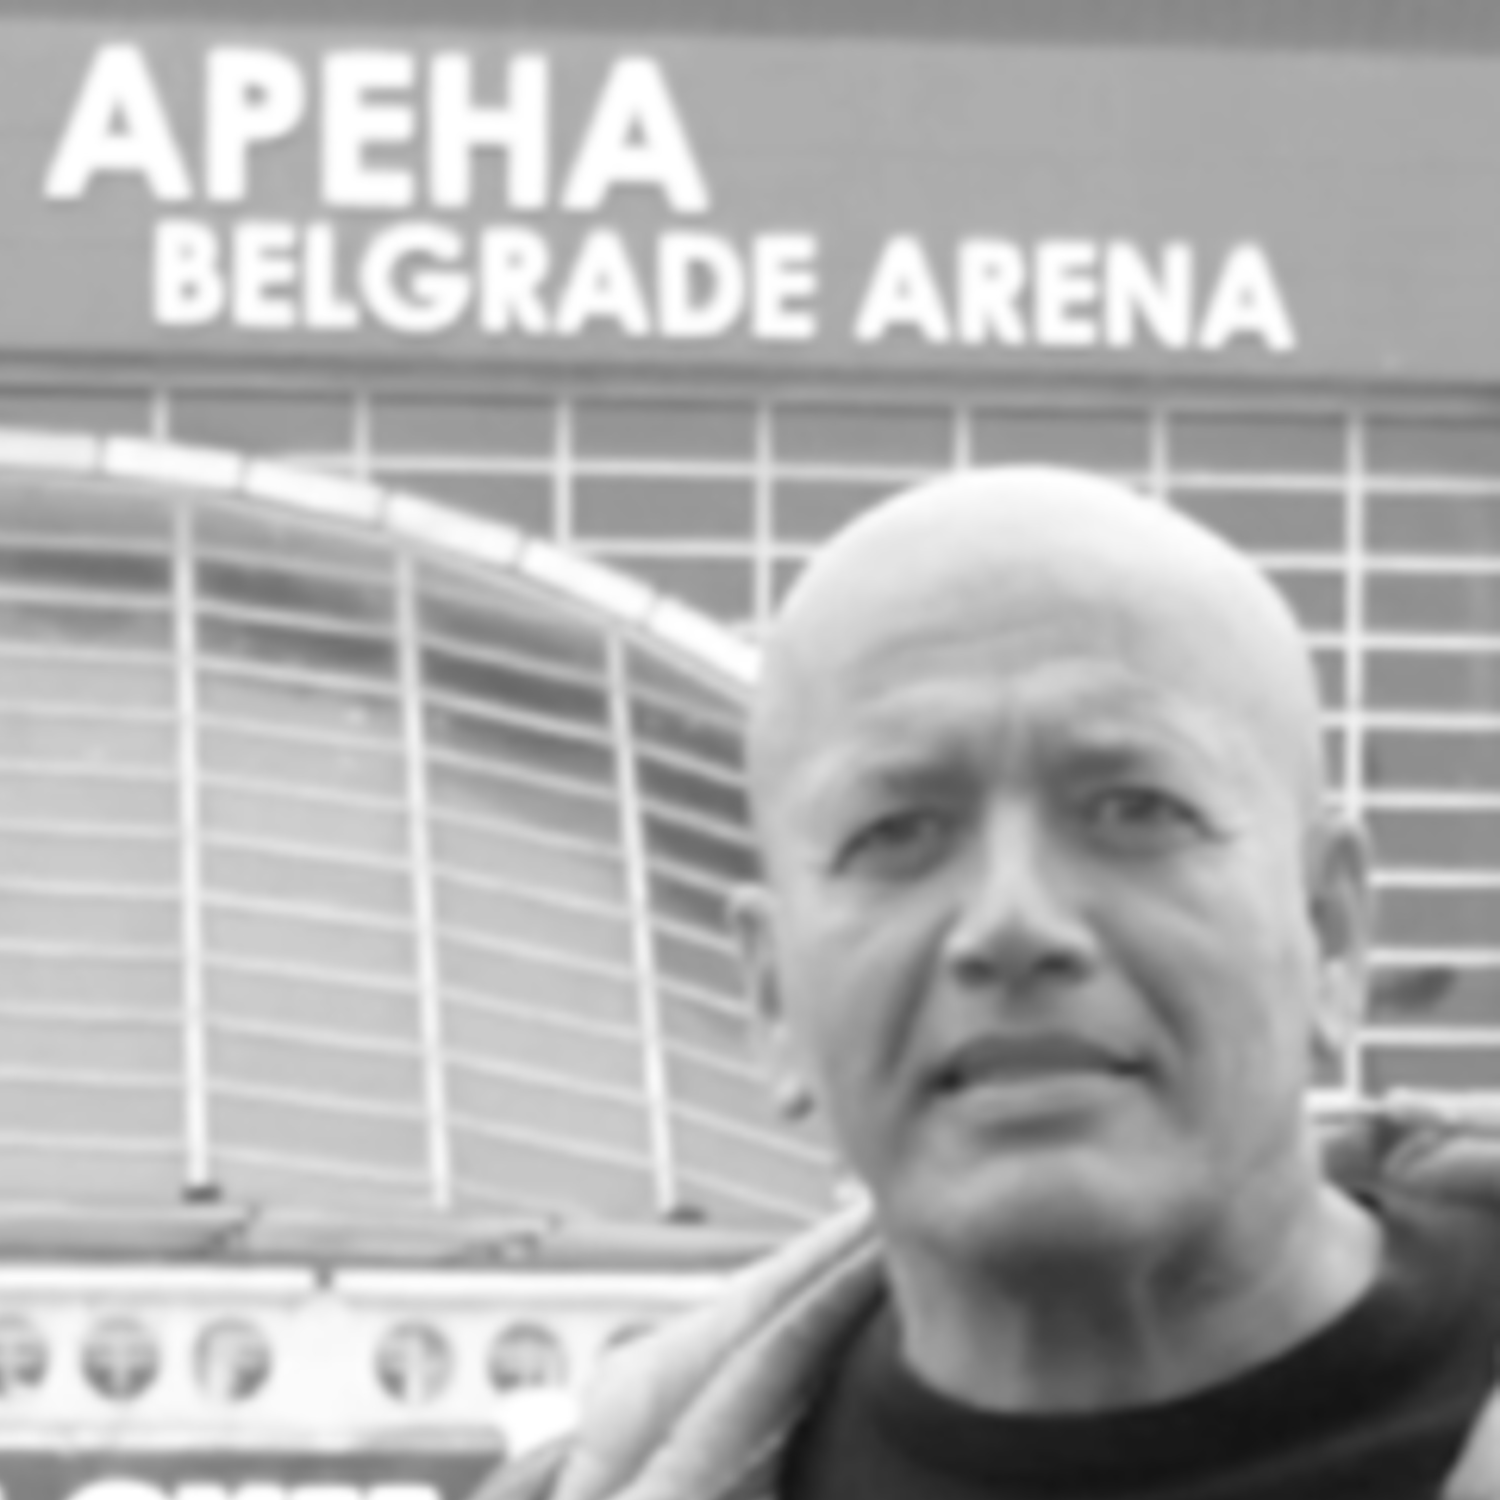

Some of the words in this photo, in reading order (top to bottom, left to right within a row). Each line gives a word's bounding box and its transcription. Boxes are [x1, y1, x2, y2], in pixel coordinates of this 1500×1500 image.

[42, 40, 711, 215] АРЕНА
[150, 217, 819, 340] BELGRADE
[852, 233, 1297, 352] ARENA
